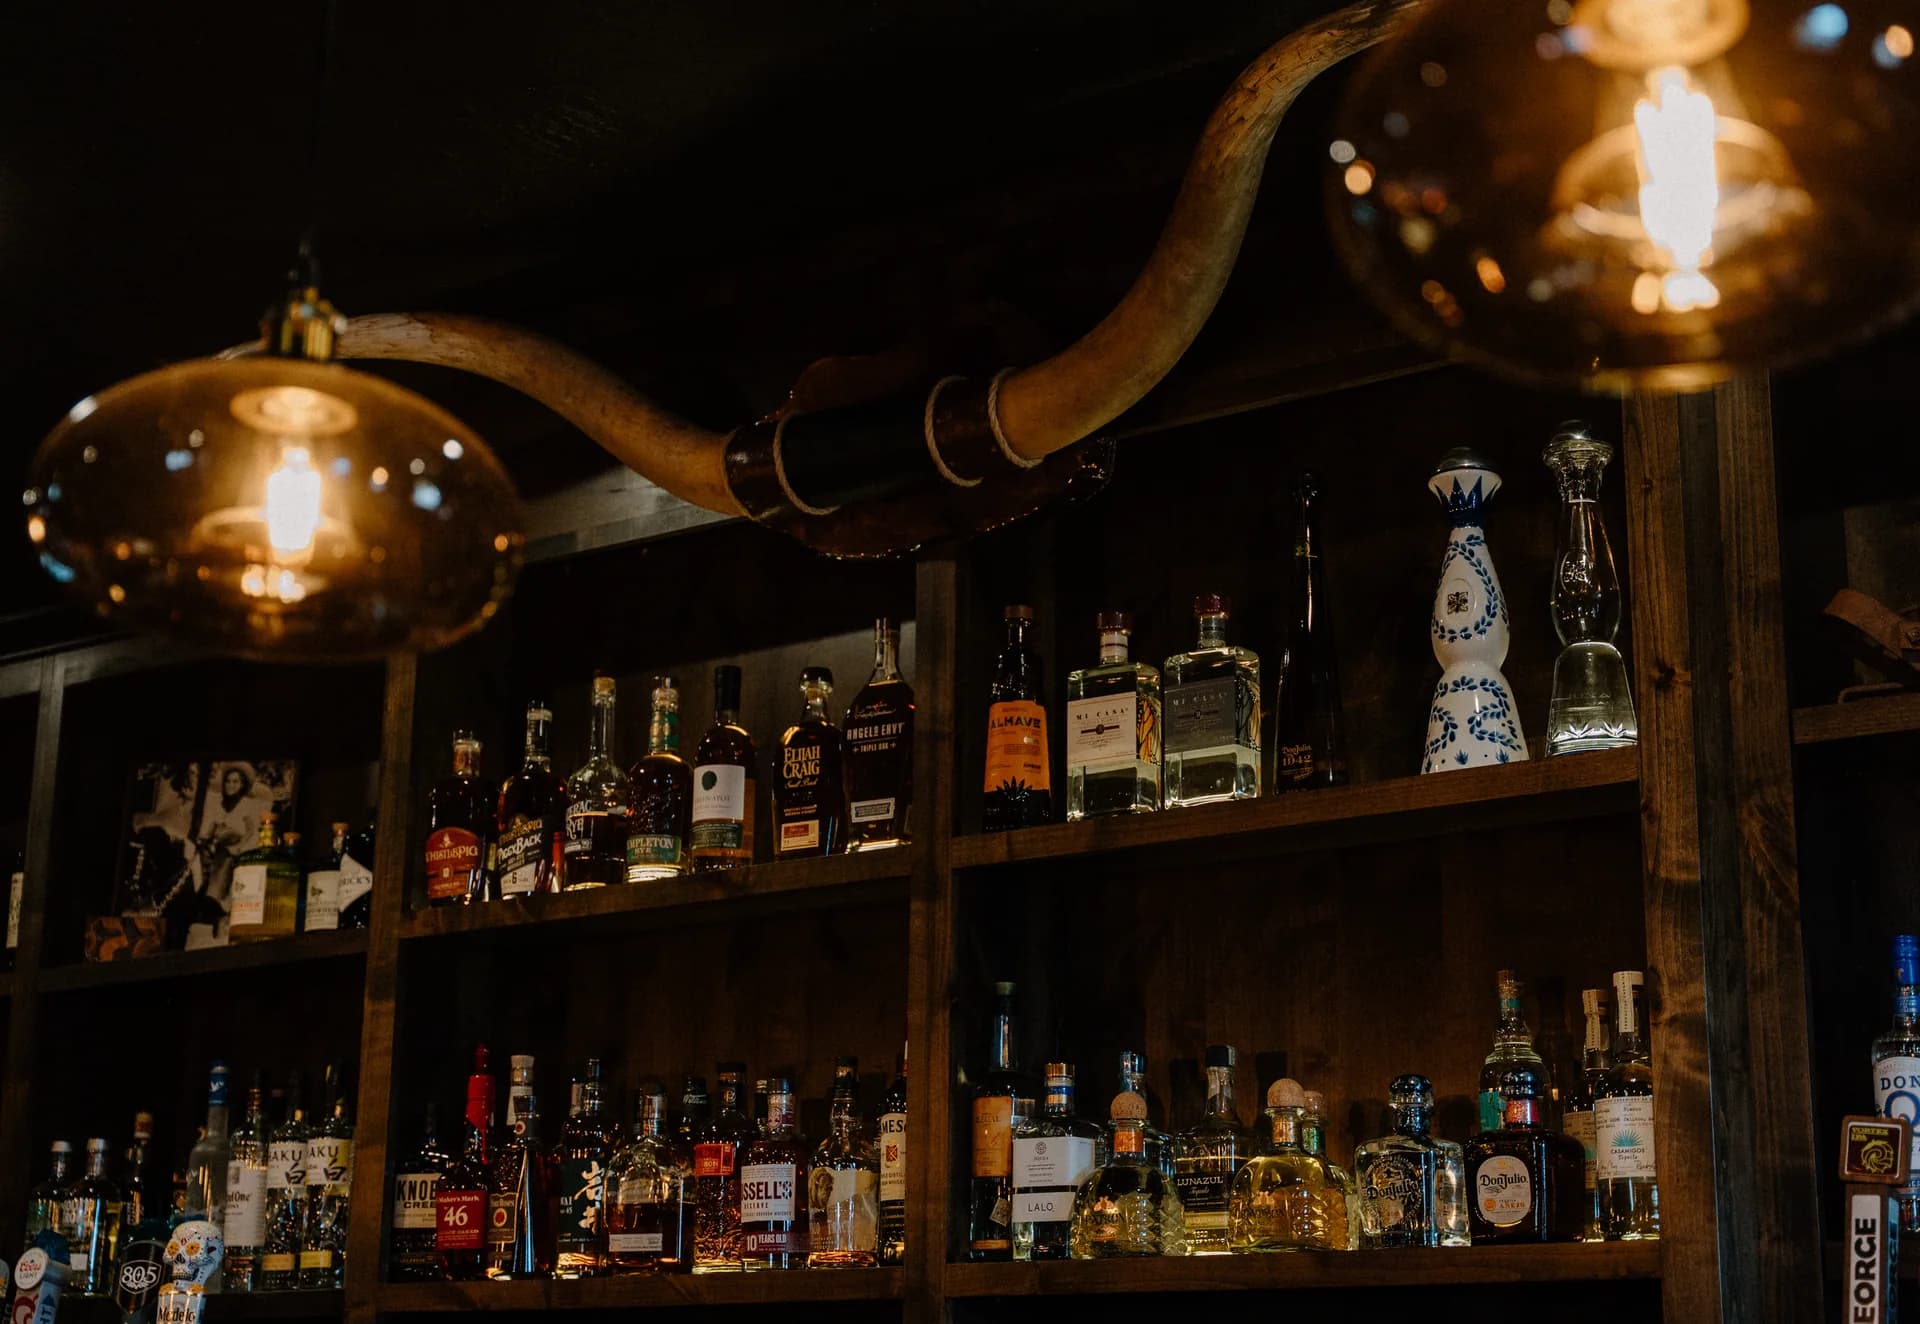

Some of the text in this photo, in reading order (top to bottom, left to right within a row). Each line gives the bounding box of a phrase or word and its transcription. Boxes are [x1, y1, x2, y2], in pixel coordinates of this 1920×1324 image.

[881, 722, 904, 735] ENVY
[991, 716, 1041, 728] ALMAVE
[784, 745, 821, 763] ELIJAH
[783, 760, 820, 779] CRAIG
[310, 1146, 338, 1157] AKU
[1177, 1176, 1223, 1186] LUNAZUL
[444, 1205, 468, 1226] 46
[1028, 1203, 1054, 1212] LALO
[747, 1234, 787, 1251] 10 YEARS OLD
[121, 1266, 158, 1284] 805
[1854, 1219, 1876, 1323] EORGE
[158, 1307, 195, 1322] Modelo
